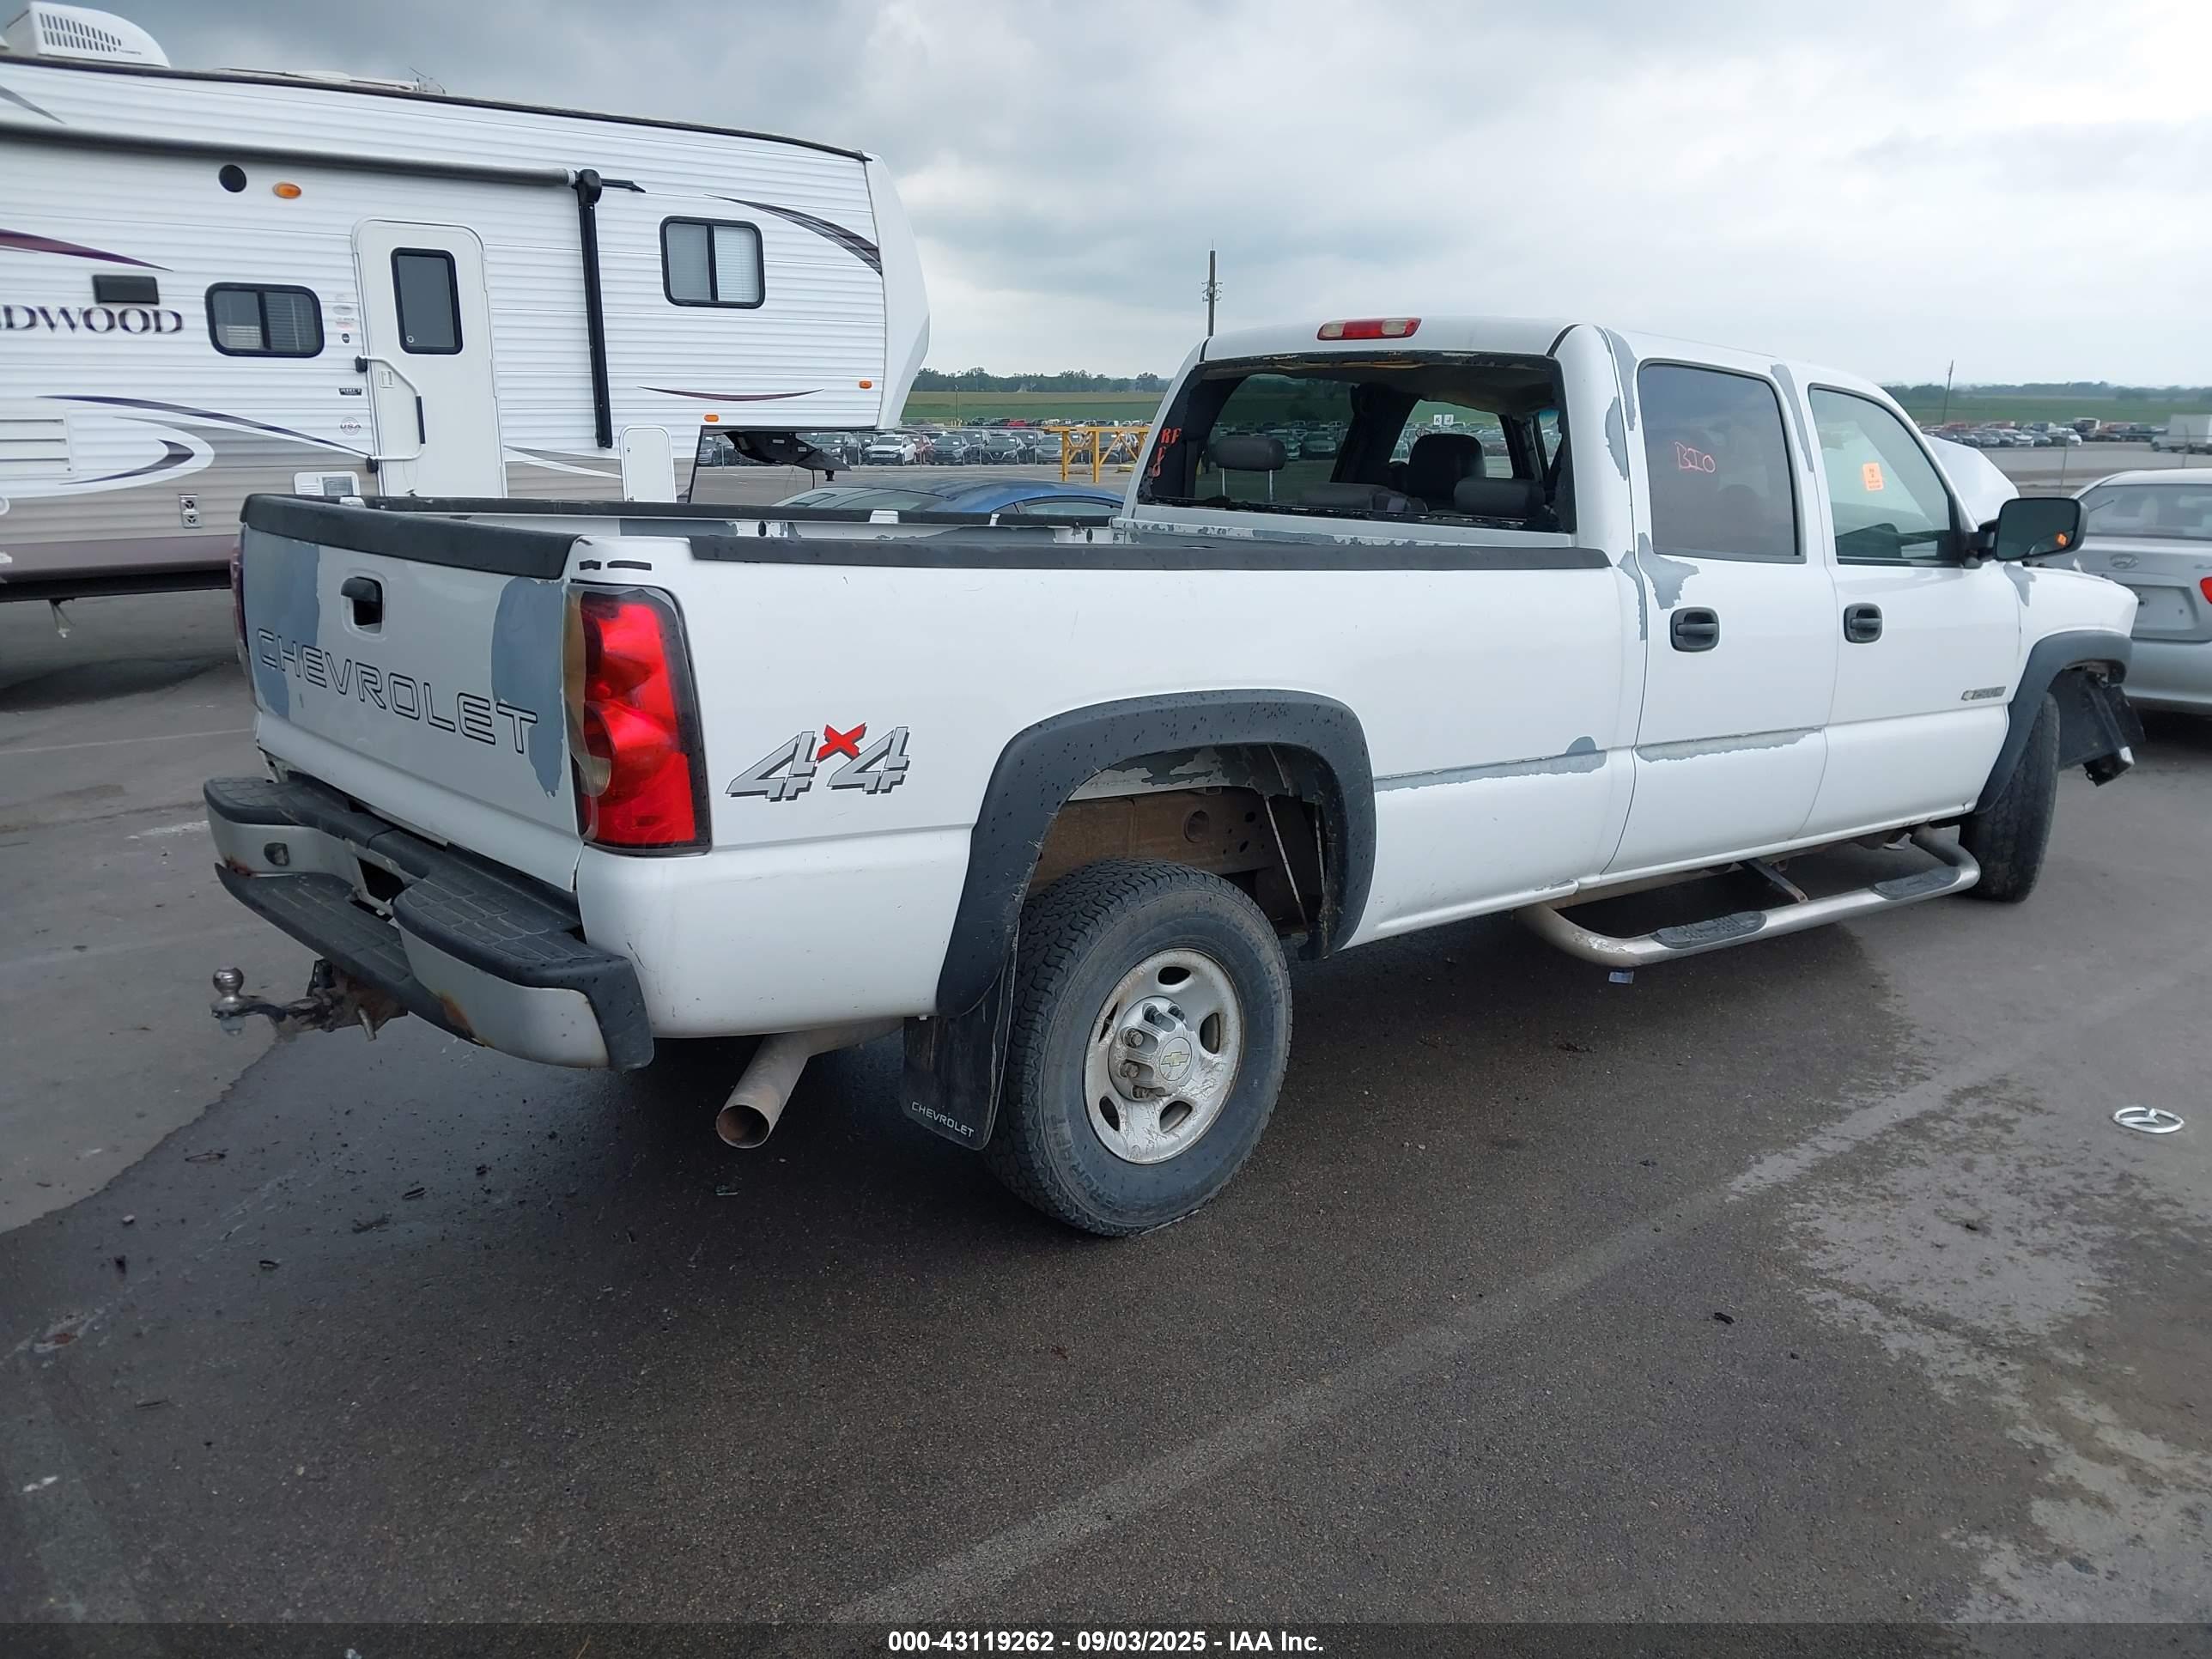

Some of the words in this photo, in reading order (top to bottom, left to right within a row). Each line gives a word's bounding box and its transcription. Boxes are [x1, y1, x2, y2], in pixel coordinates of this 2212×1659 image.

[0, 304, 185, 334] DWOOD
[258, 628, 538, 754] CHEVROLET
[911, 1101, 975, 1138] CHEVROLET
